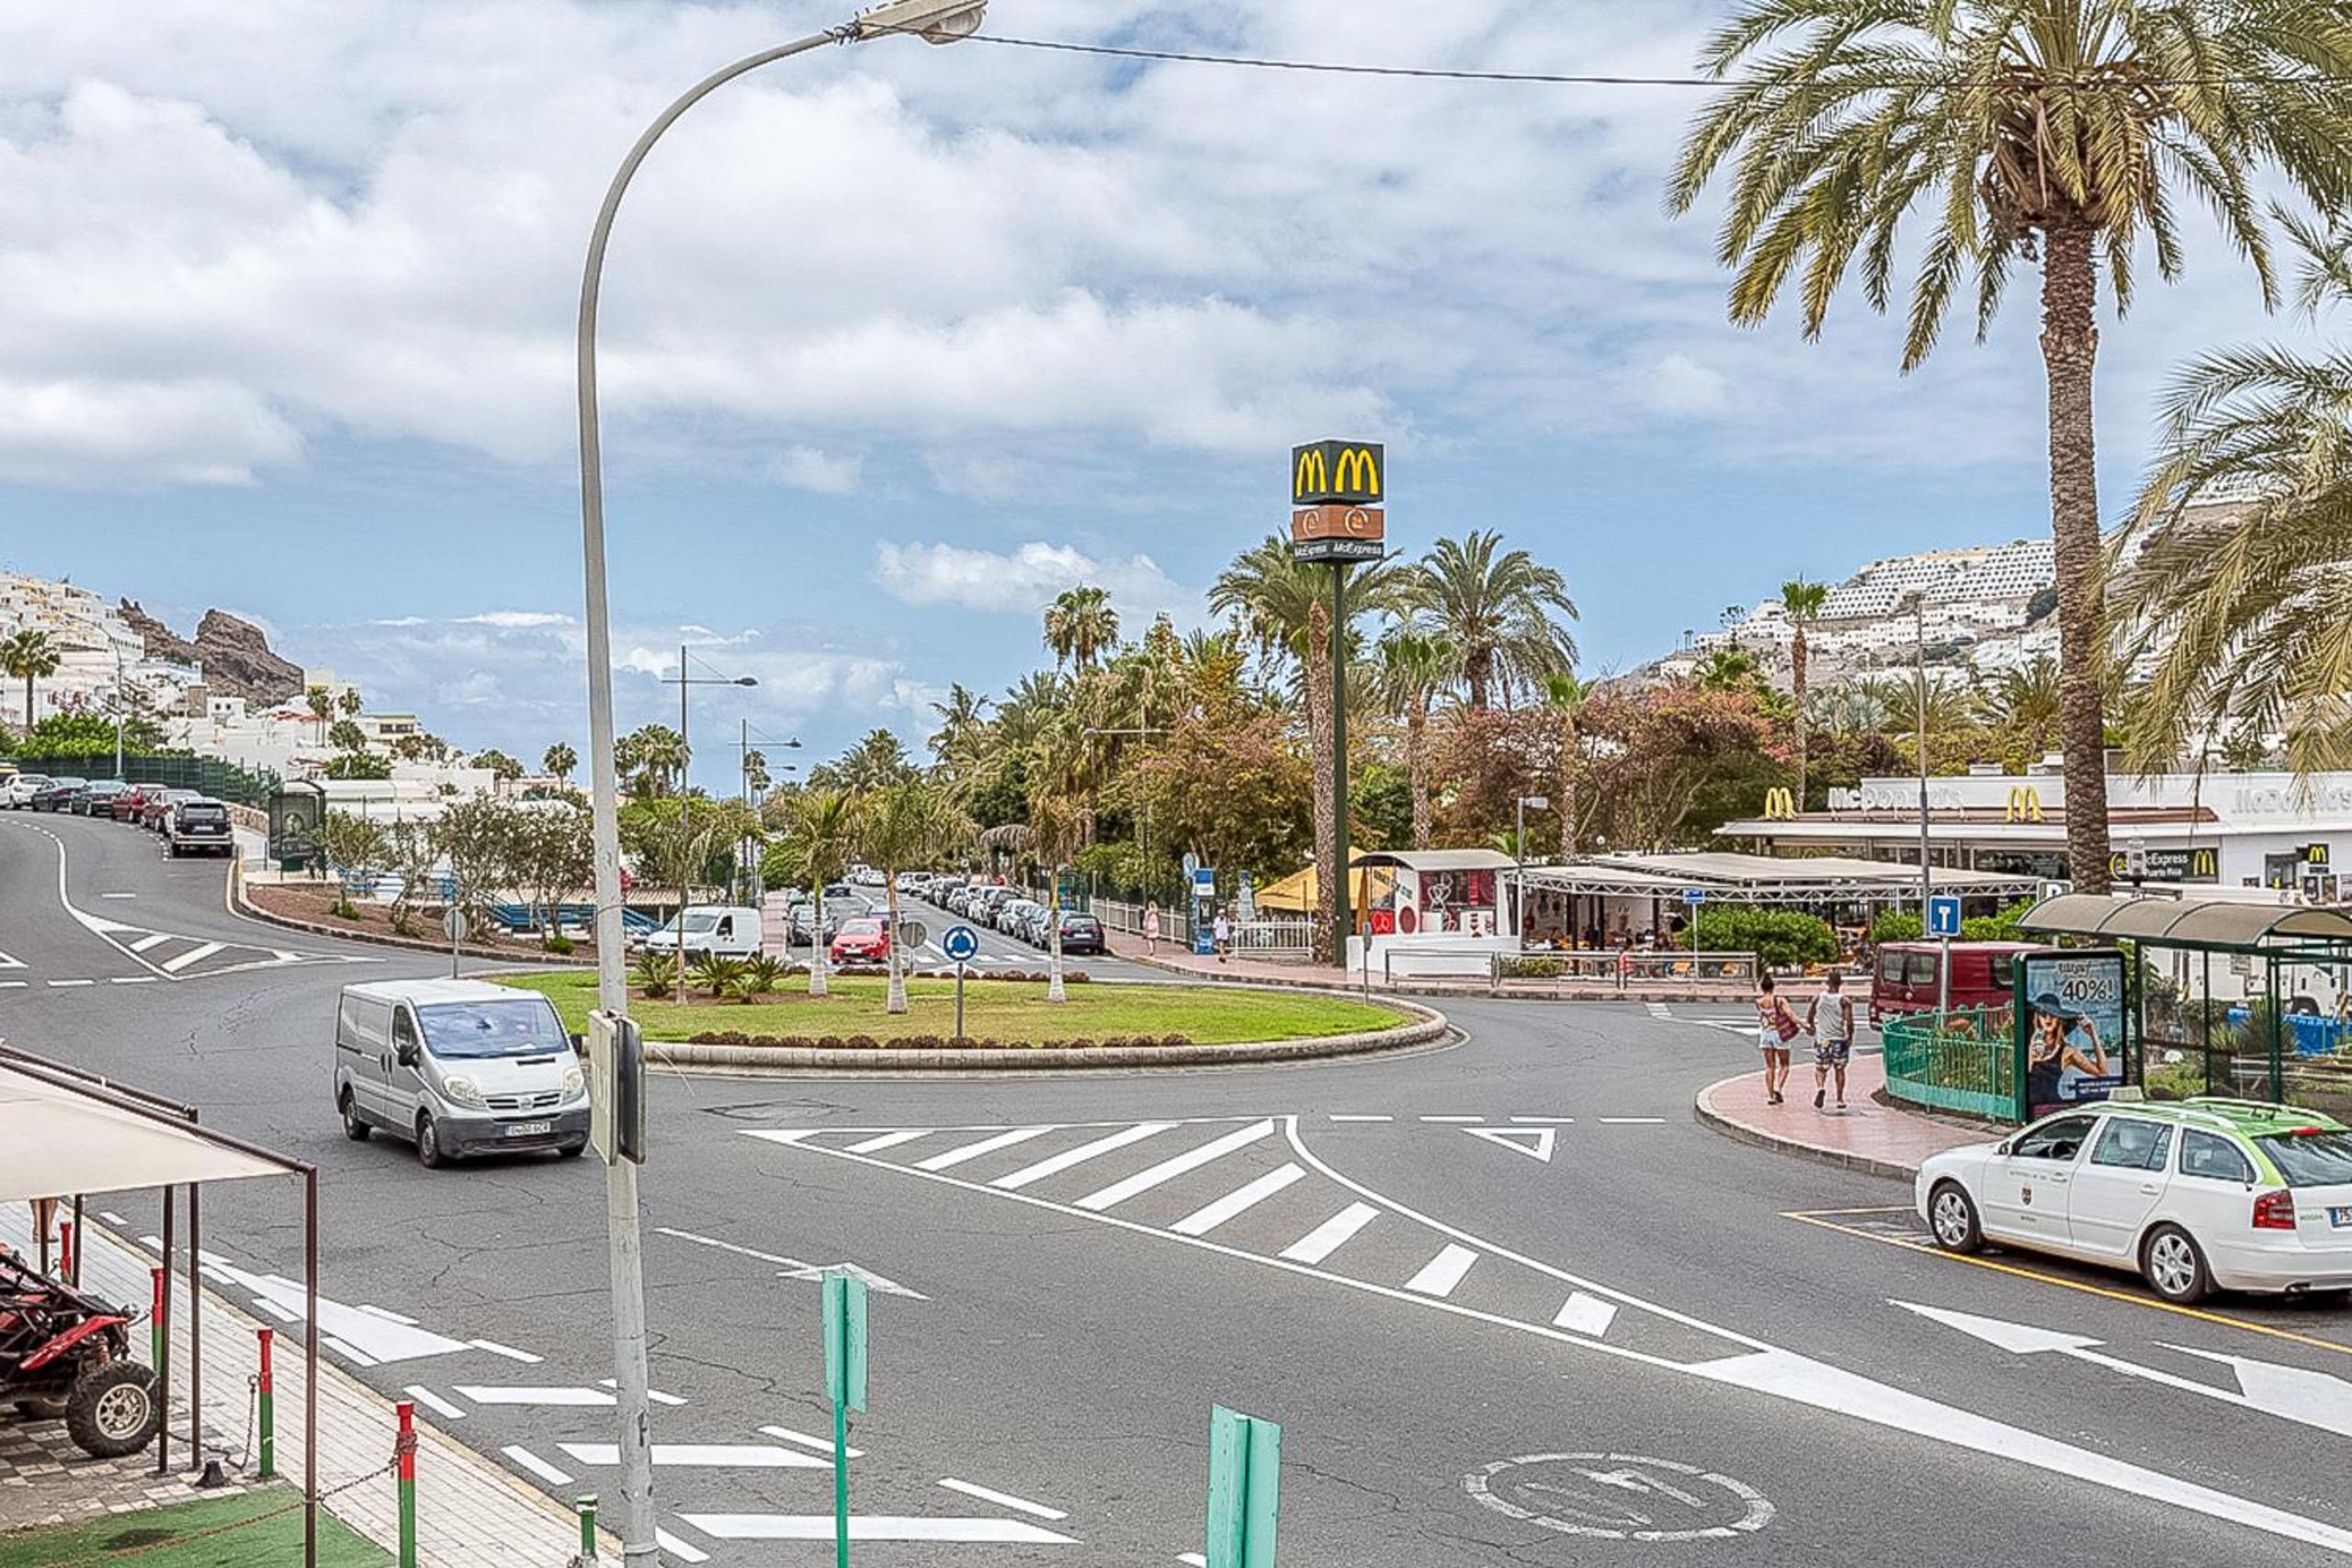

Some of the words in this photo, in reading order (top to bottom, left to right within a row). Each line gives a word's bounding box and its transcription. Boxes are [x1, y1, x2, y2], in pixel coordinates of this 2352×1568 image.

[1296, 449, 1327, 498] M
[1334, 448, 1379, 494] M
[1827, 787, 1963, 809] McDond's
[2145, 852, 2188, 866] cExpress
[2062, 979, 2113, 1001] 40%!
